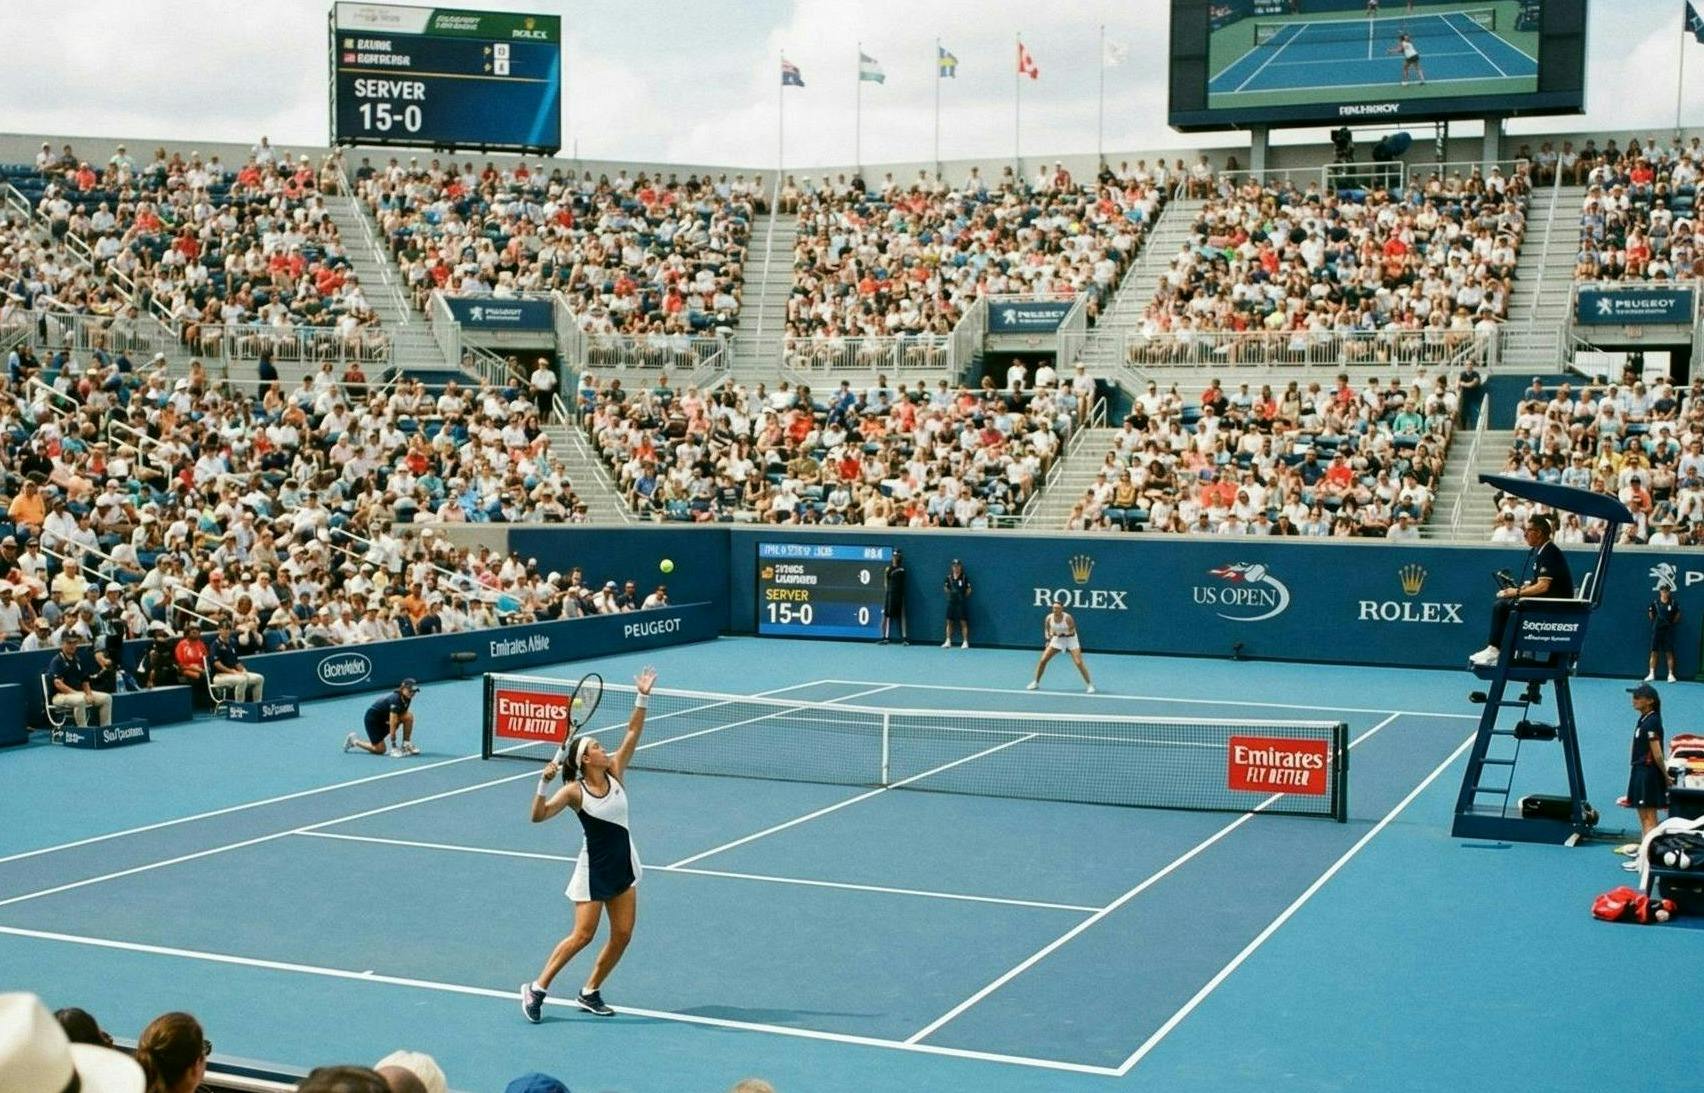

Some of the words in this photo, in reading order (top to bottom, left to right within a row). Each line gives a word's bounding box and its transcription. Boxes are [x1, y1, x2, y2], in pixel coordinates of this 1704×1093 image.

[354, 79, 425, 100] SERVER
[359, 103, 422, 132] 15-0
[765, 588, 809, 601] SERVER
[1033, 588, 1128, 610] ROLEX
[1193, 586, 1217, 604] US
[1221, 587, 1277, 606] OPEN
[767, 603, 813, 625] 15-0
[858, 606, 870, 625] 0
[1358, 600, 1464, 624] ROLEX
[624, 618, 681, 639] PEUGEOT
[499, 698, 567, 720] Emirates
[1234, 745, 1323, 769] Emirates
